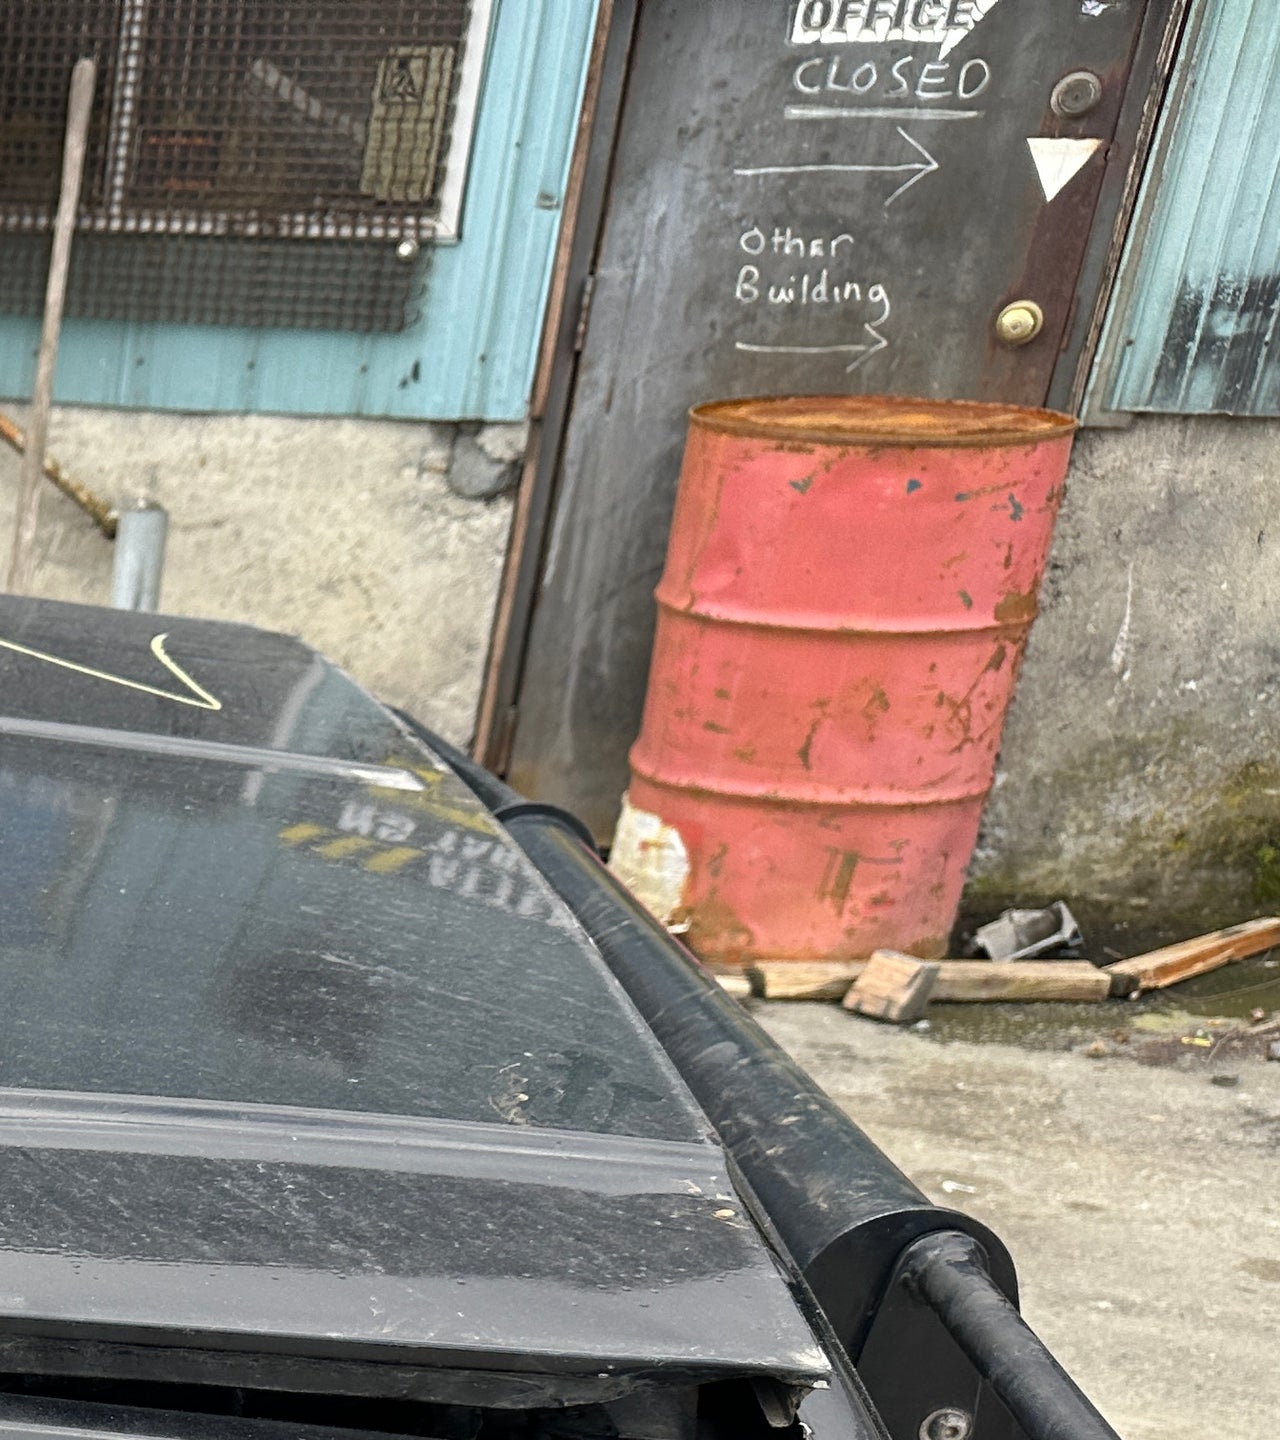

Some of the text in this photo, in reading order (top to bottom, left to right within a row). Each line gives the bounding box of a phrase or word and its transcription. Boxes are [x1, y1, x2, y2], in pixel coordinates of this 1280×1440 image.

[794, 0, 978, 40] OFFICE
[793, 56, 990, 99] CLOSED
[739, 226, 855, 257] Other
[735, 264, 890, 327] Building
